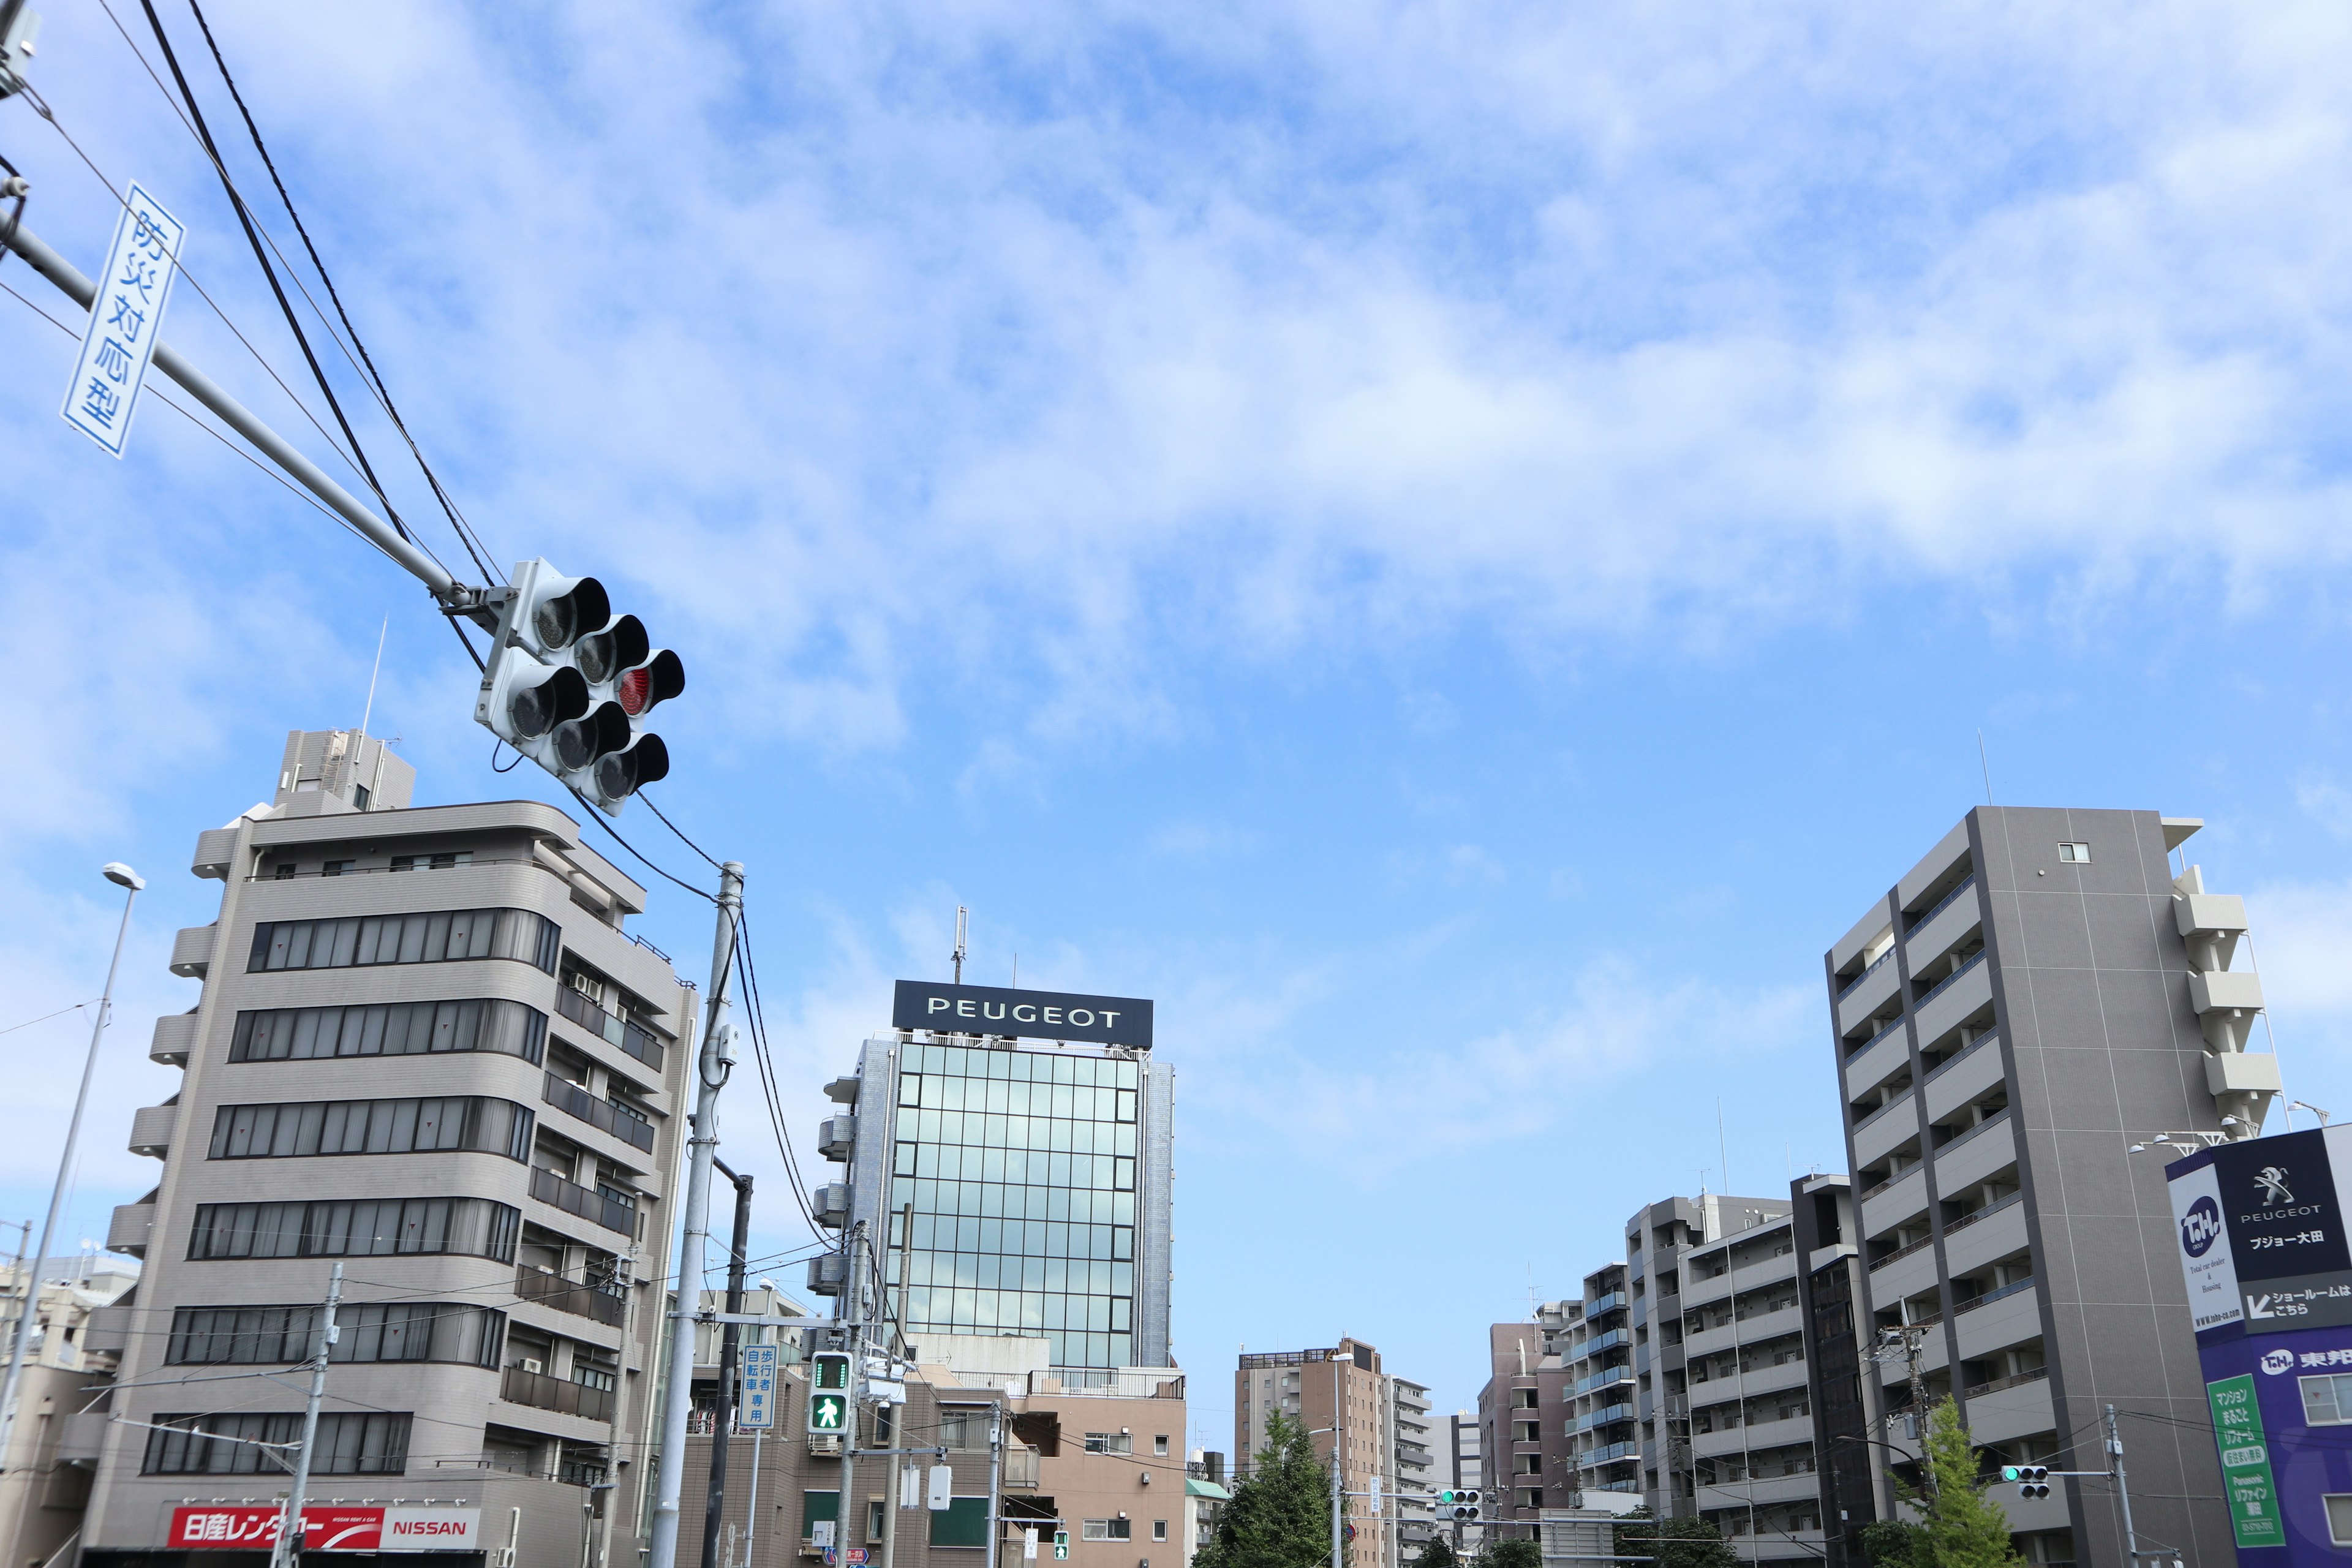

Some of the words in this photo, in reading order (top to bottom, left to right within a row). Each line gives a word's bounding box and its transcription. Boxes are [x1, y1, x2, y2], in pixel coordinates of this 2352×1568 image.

[80, 209, 168, 430] 防災対応型
[927, 997, 1121, 1028] PEUGEOT
[2241, 1205, 2321, 1224] PEUGEOT
[2250, 1230, 2324, 1250] プジョー大田
[2190, 1264, 2203, 1274] Total
[2211, 1257, 2225, 1268] dealer
[2202, 1283, 2222, 1294] Housing
[2272, 1285, 2351, 1303] ショールームは
[2275, 1303, 2309, 1316] こちら
[745, 1349, 759, 1391] 自転車
[760, 1349, 773, 1391] 歩行者
[2215, 1389, 2247, 1406] マンション
[750, 1394, 763, 1422] 専用
[2222, 1407, 2250, 1425] まるごと
[2224, 1427, 2255, 1445] リフォーム
[2234, 1487, 2267, 1502] リファイン
[393, 1522, 467, 1536] NISSAN
